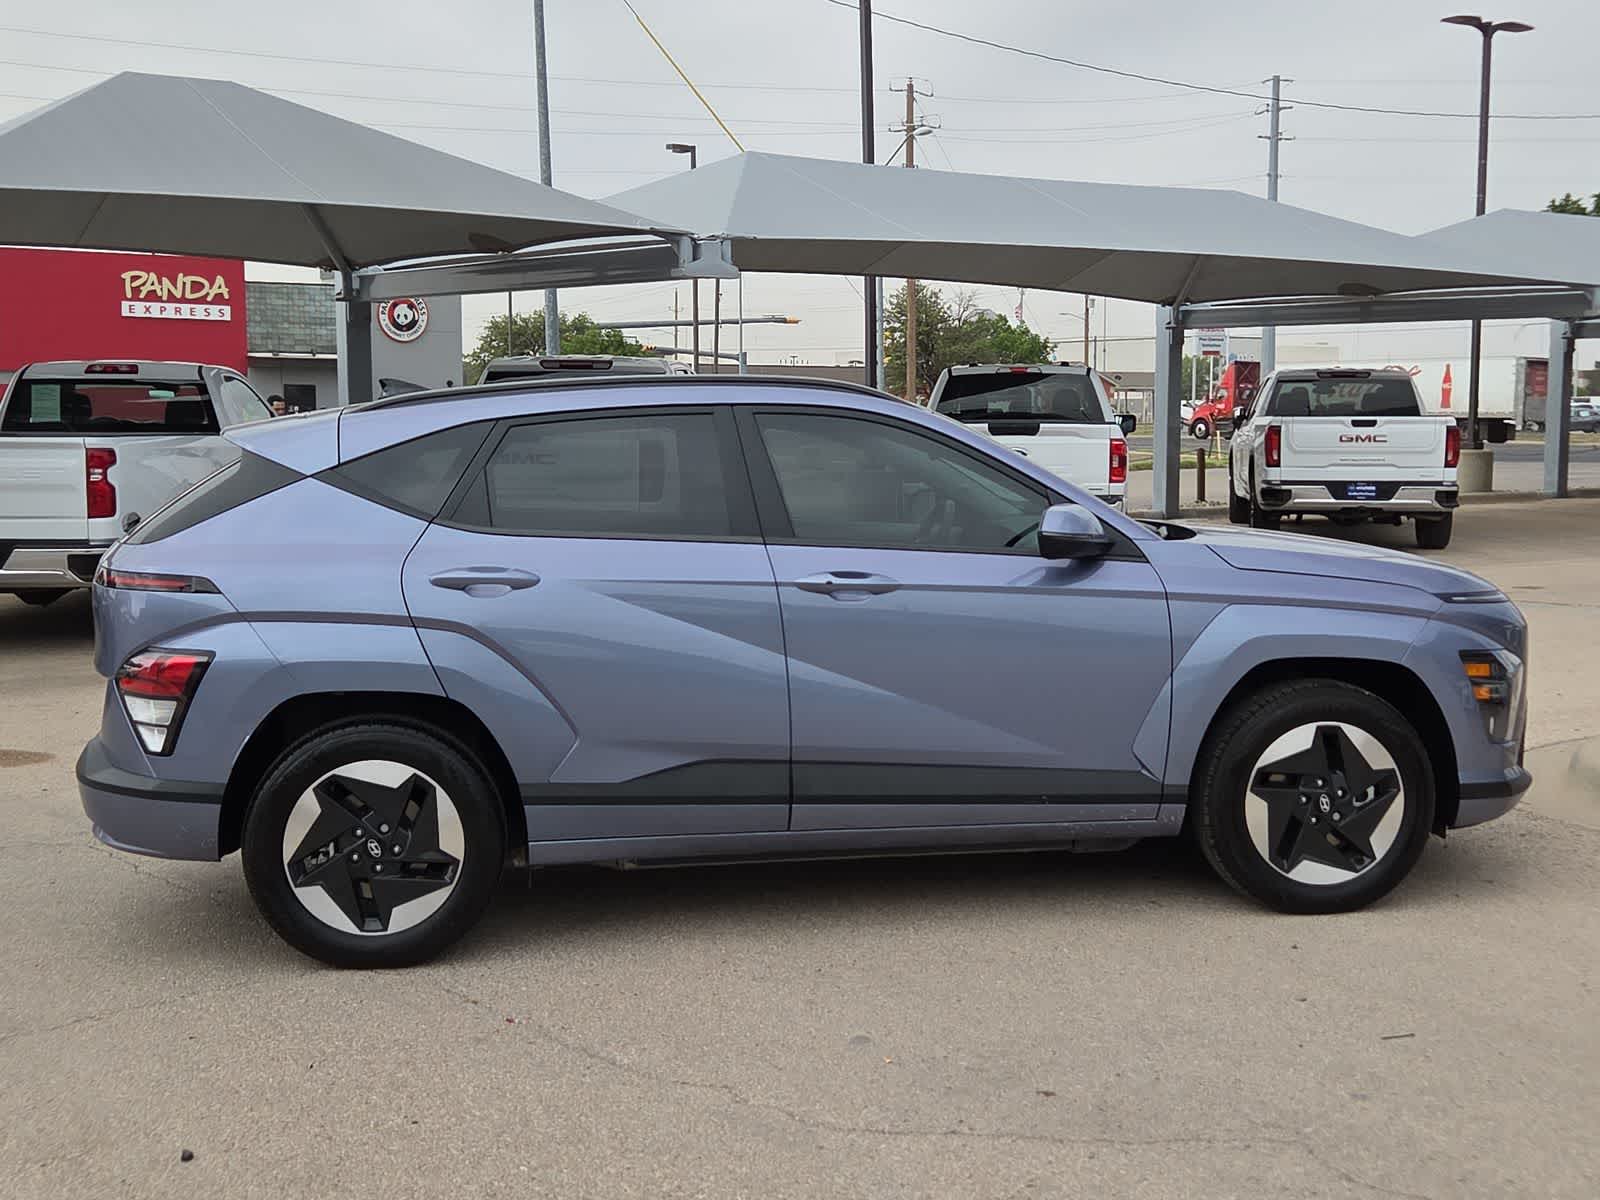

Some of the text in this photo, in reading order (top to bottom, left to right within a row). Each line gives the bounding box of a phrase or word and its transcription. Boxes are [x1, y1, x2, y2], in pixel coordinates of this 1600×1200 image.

[121, 270, 229, 301] PANDA
[128, 304, 225, 318] EXPRESS
[1338, 433, 1388, 444] GMC
